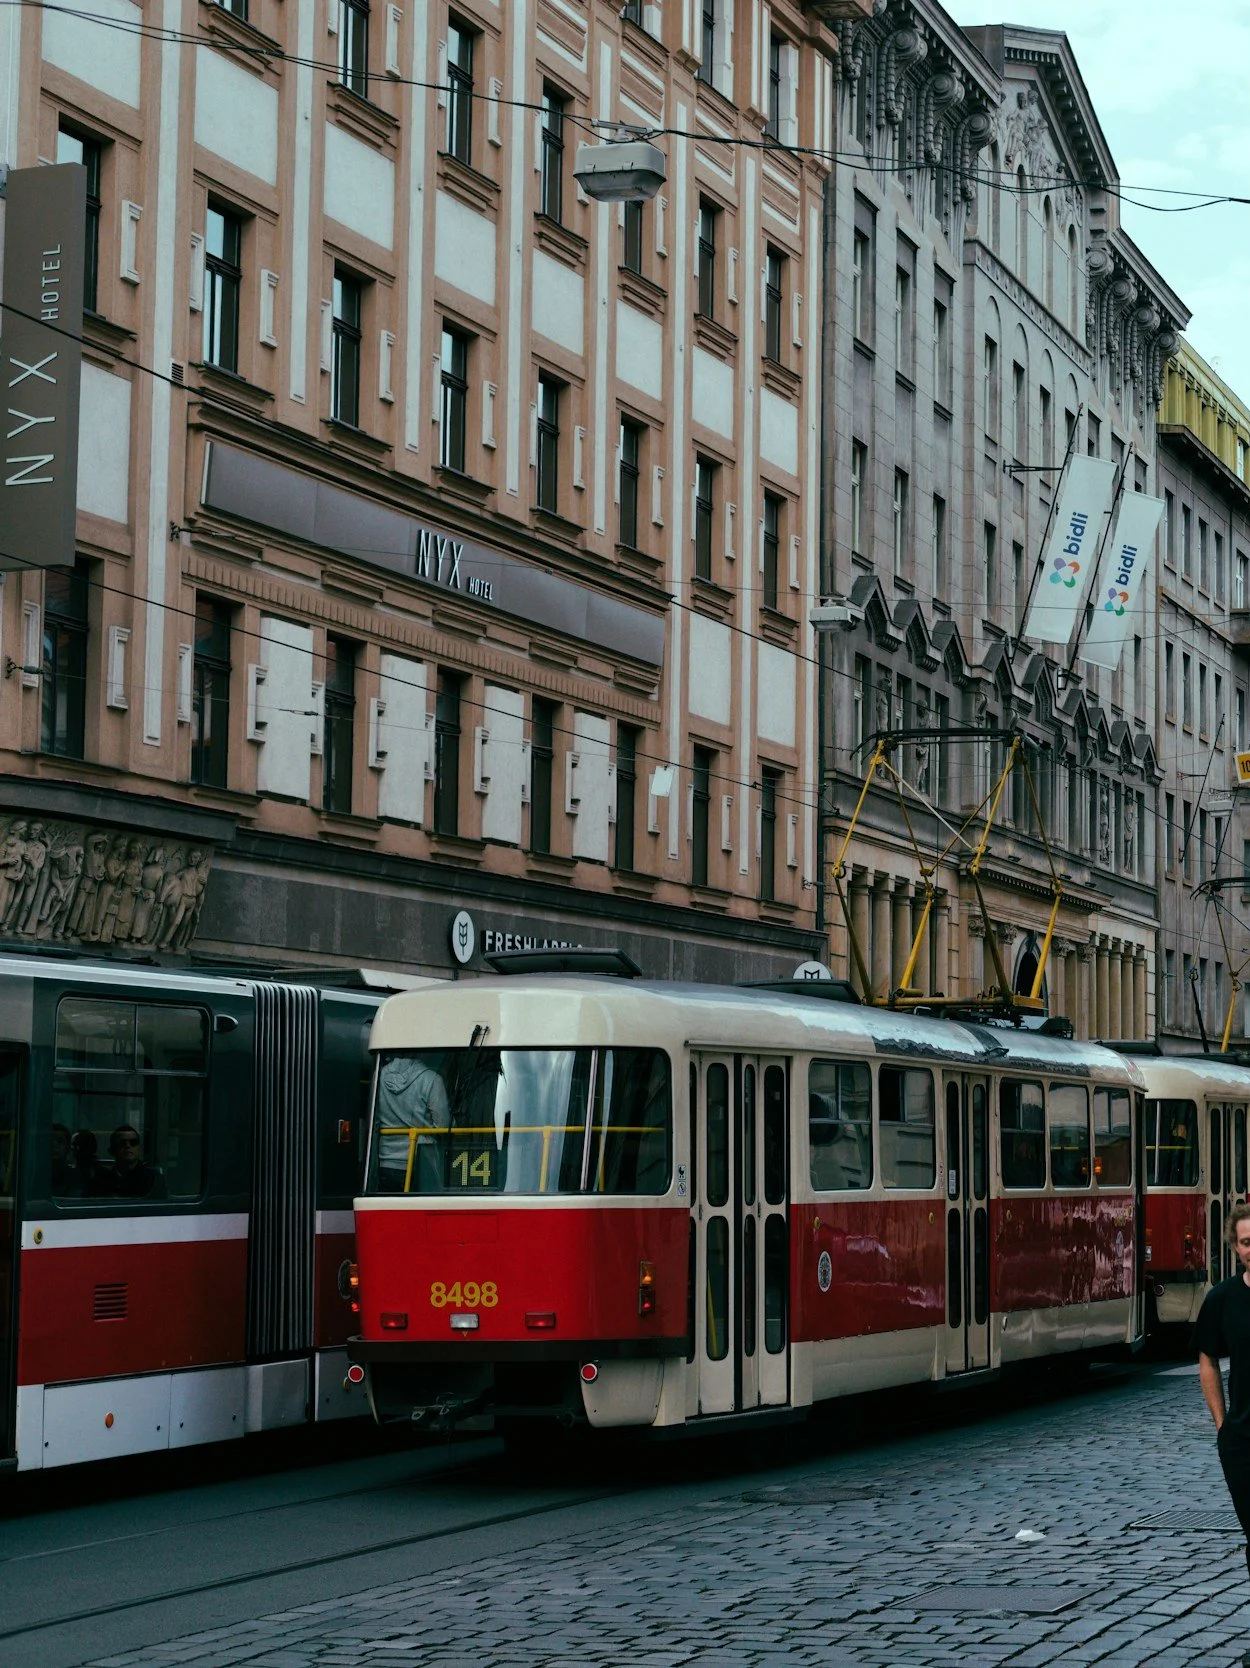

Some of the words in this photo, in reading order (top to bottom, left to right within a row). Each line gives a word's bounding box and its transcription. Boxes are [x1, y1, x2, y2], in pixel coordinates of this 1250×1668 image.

[6, 352, 58, 486] NYX
[41, 243, 62, 321] HOTEL
[1063, 511, 1089, 555] bidli
[418, 528, 464, 589] NYX
[469, 576, 493, 600] HOTEL
[1115, 544, 1138, 586] bidli
[452, 1151, 490, 1186] 14
[430, 1282, 499, 1308] 8498
